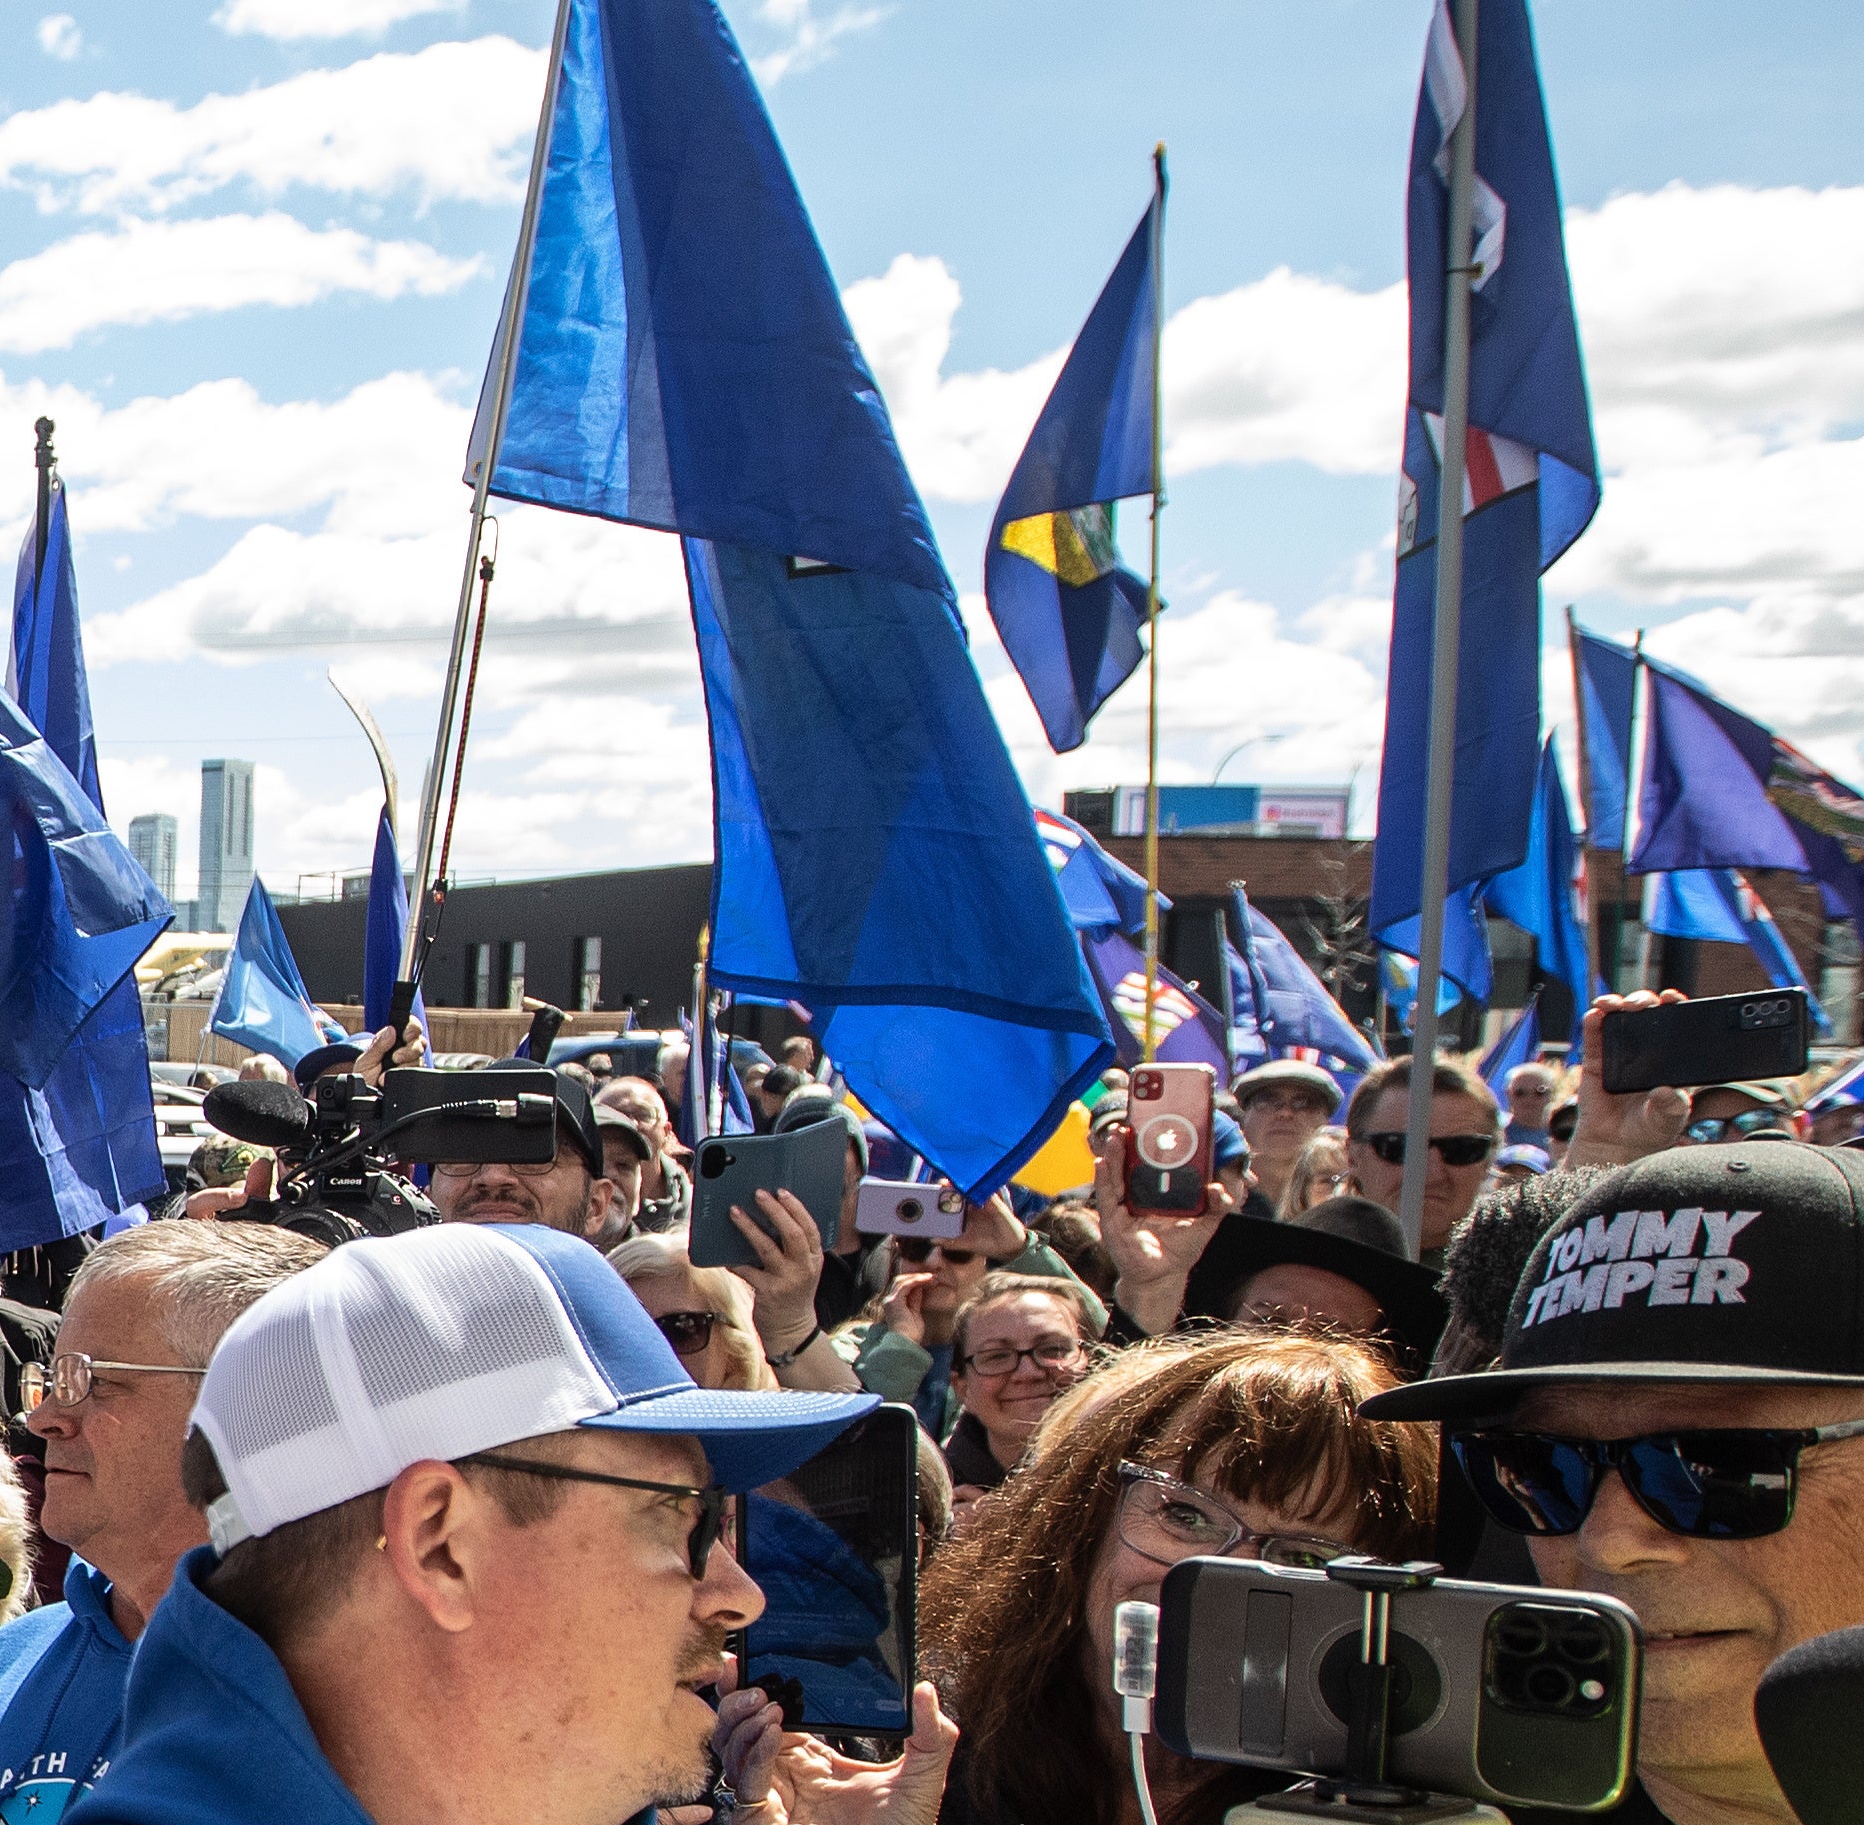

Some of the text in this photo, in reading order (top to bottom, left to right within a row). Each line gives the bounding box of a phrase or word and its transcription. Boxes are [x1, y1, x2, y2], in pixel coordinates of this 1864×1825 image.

[330, 1177, 363, 1186] Canon
[1543, 1206, 1763, 1284] TOMMY
[1521, 1256, 1751, 1330] TEMPER
